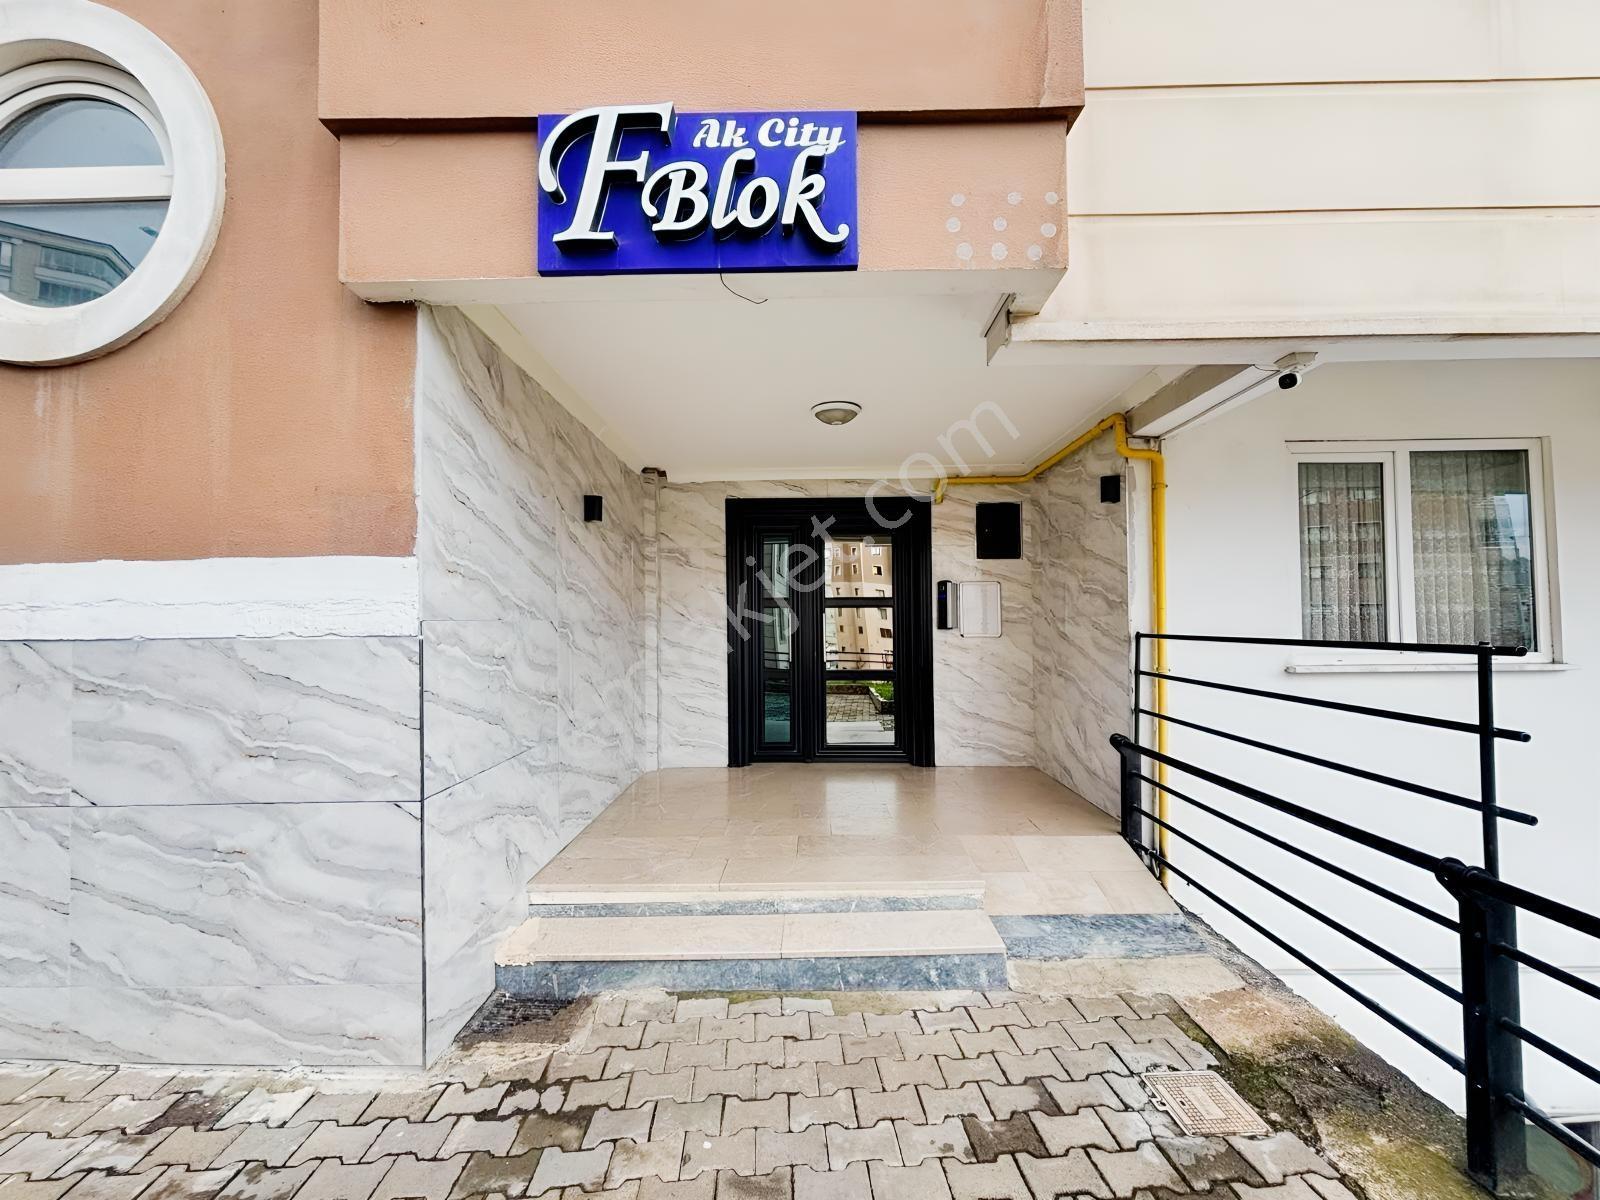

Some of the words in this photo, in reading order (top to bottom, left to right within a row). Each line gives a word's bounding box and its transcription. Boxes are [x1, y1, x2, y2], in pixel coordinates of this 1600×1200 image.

[538, 101, 674, 243] F
[641, 146, 850, 243] Blok
[692, 118, 748, 148] Ak
[757, 117, 846, 154] City
